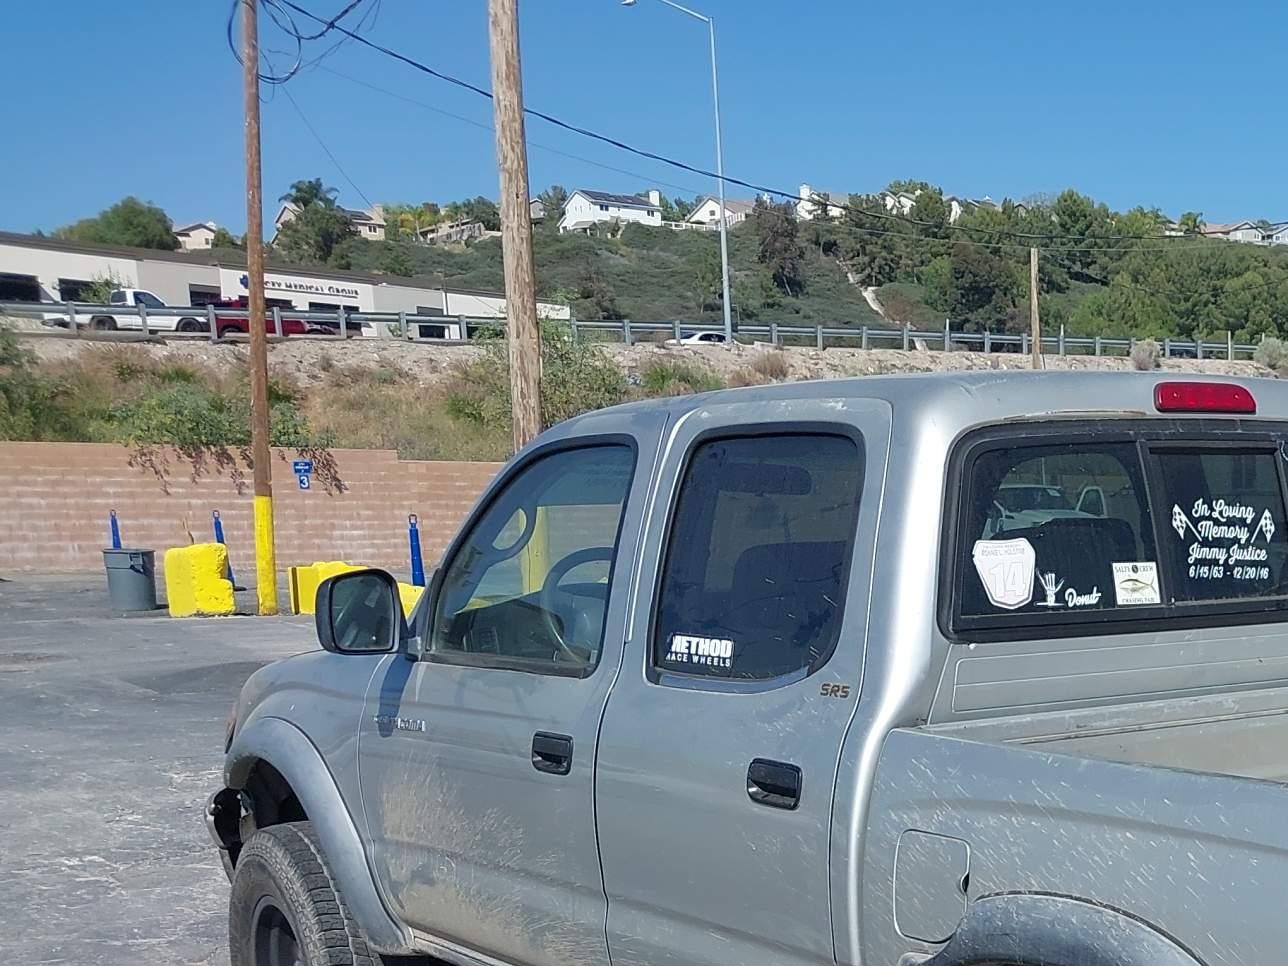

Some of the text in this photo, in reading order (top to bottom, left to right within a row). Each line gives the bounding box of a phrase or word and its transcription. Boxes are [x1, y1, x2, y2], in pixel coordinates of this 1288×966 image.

[300, 476, 309, 488] 3
[1191, 498, 1255, 524] In Loving
[1197, 520, 1250, 544] Memory
[1188, 541, 1268, 565] Jimmy Justice
[988, 561, 1027, 598] 14
[1188, 564, 1224, 580] 6/15/63
[1232, 565, 1270, 581] 12/20/16
[1065, 586, 1102, 608] Donut
[692, 655, 731, 667] WHEELS
